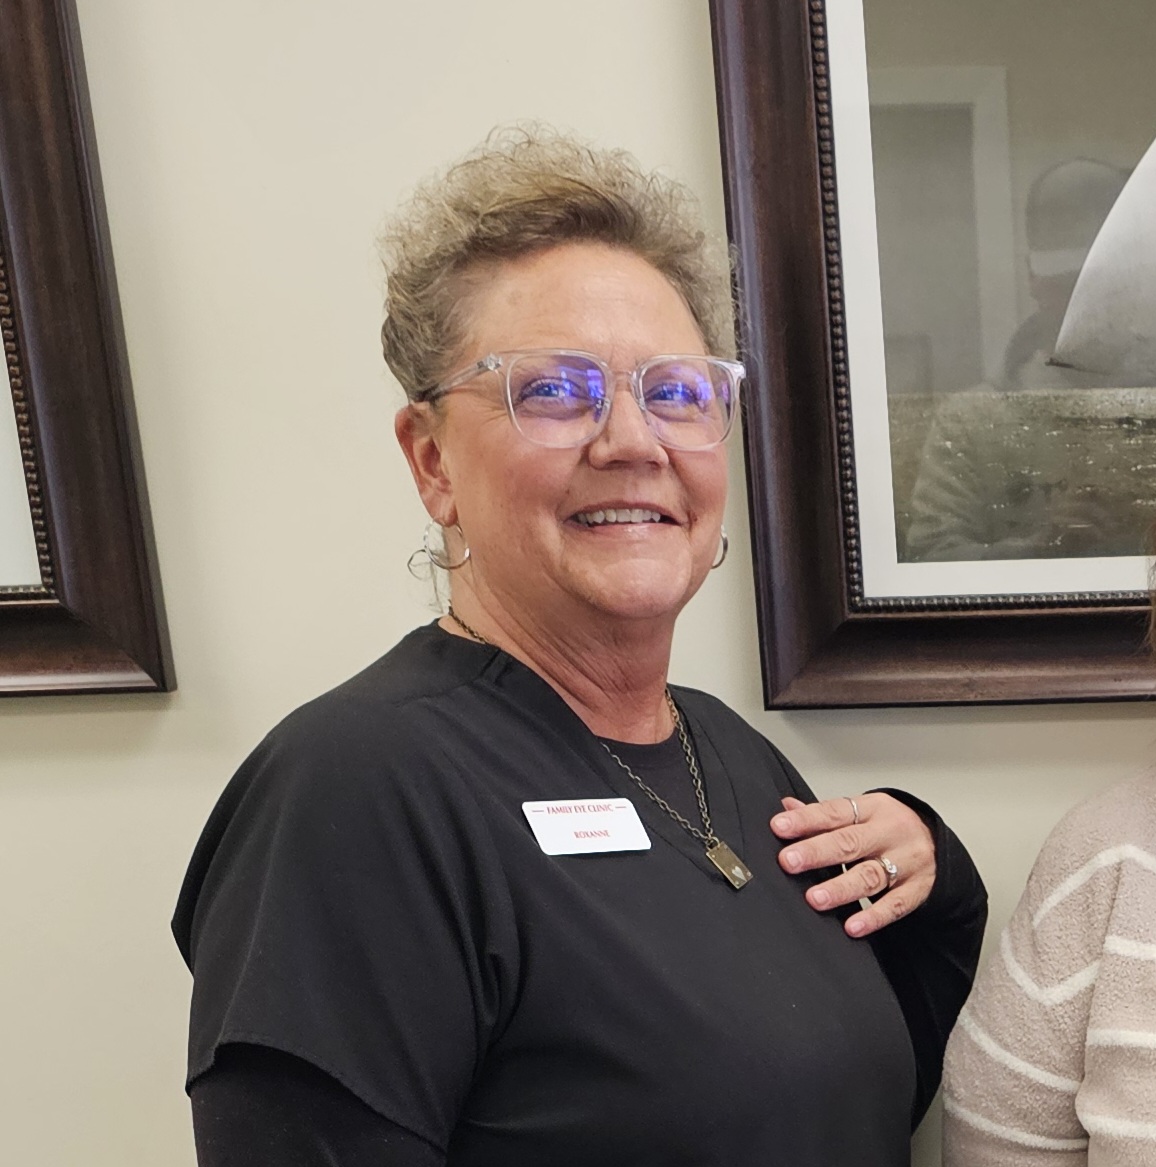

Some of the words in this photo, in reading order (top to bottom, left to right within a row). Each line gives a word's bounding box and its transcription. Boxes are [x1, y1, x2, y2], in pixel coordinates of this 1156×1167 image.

[547, 806, 573, 814] FAMILY
[574, 805, 586, 813] EYE
[588, 804, 613, 812] CLINIC
[574, 830, 610, 838] ROXANNE
